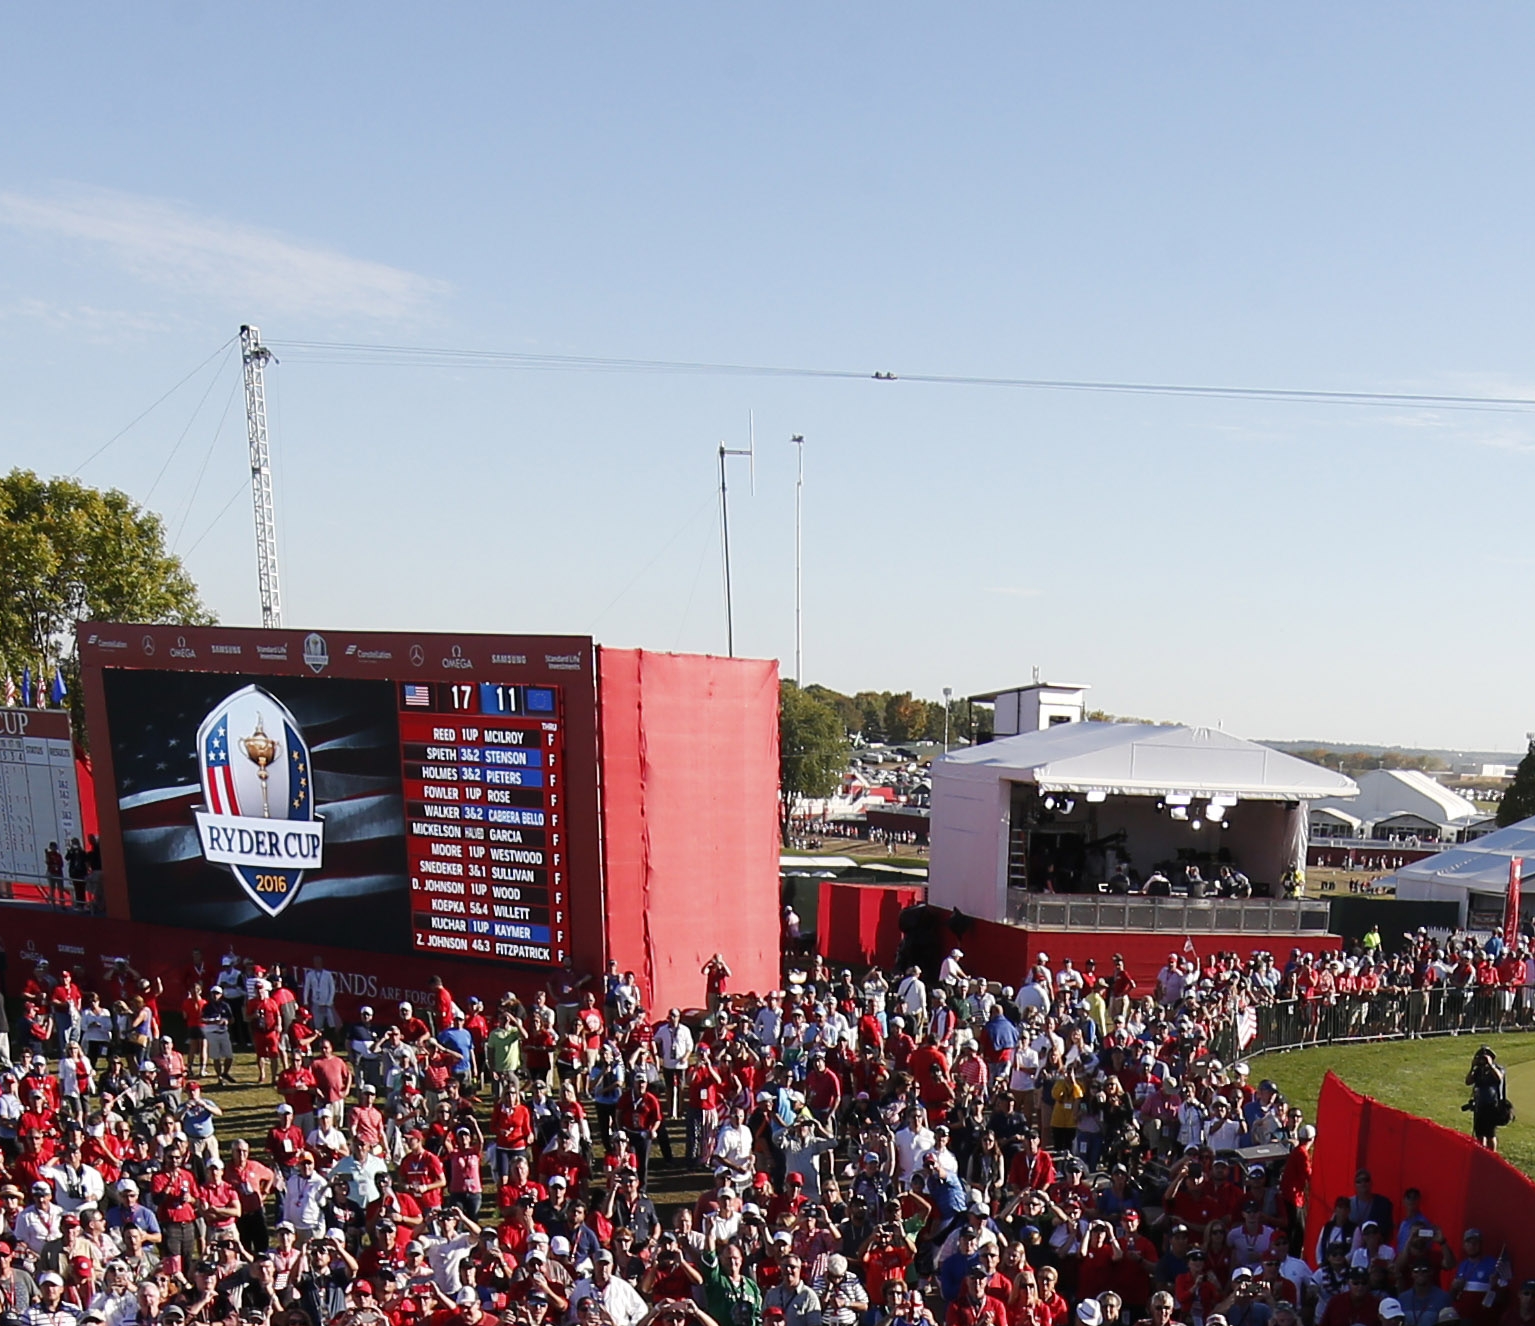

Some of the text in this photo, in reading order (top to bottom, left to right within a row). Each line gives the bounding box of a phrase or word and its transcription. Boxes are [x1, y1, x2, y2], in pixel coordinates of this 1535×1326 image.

[170, 648, 197, 659] OMEGA
[442, 657, 473, 669] OMEGA
[491, 654, 527, 664] SAMSUNG
[451, 685, 516, 711] 17 11
[433, 728, 456, 741] REED
[462, 728, 479, 741] 1UP
[484, 730, 524, 744] MCILROY
[541, 722, 558, 732] THRU
[426, 747, 457, 761] SPIETH
[461, 748, 480, 762] 3&2
[485, 750, 527, 765] STENSON
[422, 766, 458, 780] HOLMES
[462, 767, 481, 781] 3&2
[486, 769, 522, 785] PIETERS
[423, 786, 459, 800] FOWLER
[465, 787, 482, 800] 1UP
[487, 789, 511, 804] ROSE
[424, 804, 460, 819] WALKER
[464, 807, 483, 820] 3&2
[488, 809, 521, 824] CABRERA
[522, 812, 544, 826] BELLO
[208, 825, 321, 858] RYDER CUP
[412, 823, 461, 838] MICKELSON
[489, 828, 523, 843] GARCIA
[431, 843, 462, 858] MOORE
[468, 846, 485, 858] 1UP
[490, 848, 543, 865] WESTWOOD
[419, 860, 463, 875] SNEDEKER
[468, 864, 486, 877] 3&1
[491, 867, 535, 882] SULLIVAN
[255, 874, 287, 893] 2016
[412, 878, 421, 890] D.
[424, 879, 465, 894] JOHNSON
[470, 883, 488, 895] 1UP
[492, 886, 520, 900] WOOD
[431, 899, 466, 913] KOEPKA
[469, 902, 489, 915] 5&4
[493, 905, 530, 920] WILLETT
[431, 917, 466, 932] KUCHAR
[472, 921, 490, 934] 1UP
[494, 924, 531, 939] KAYMER
[416, 933, 425, 945] Z.
[427, 935, 468, 950] JOHNSON
[471, 939, 491, 952] 4&3
[495, 942, 551, 961] FITZPATRICK
